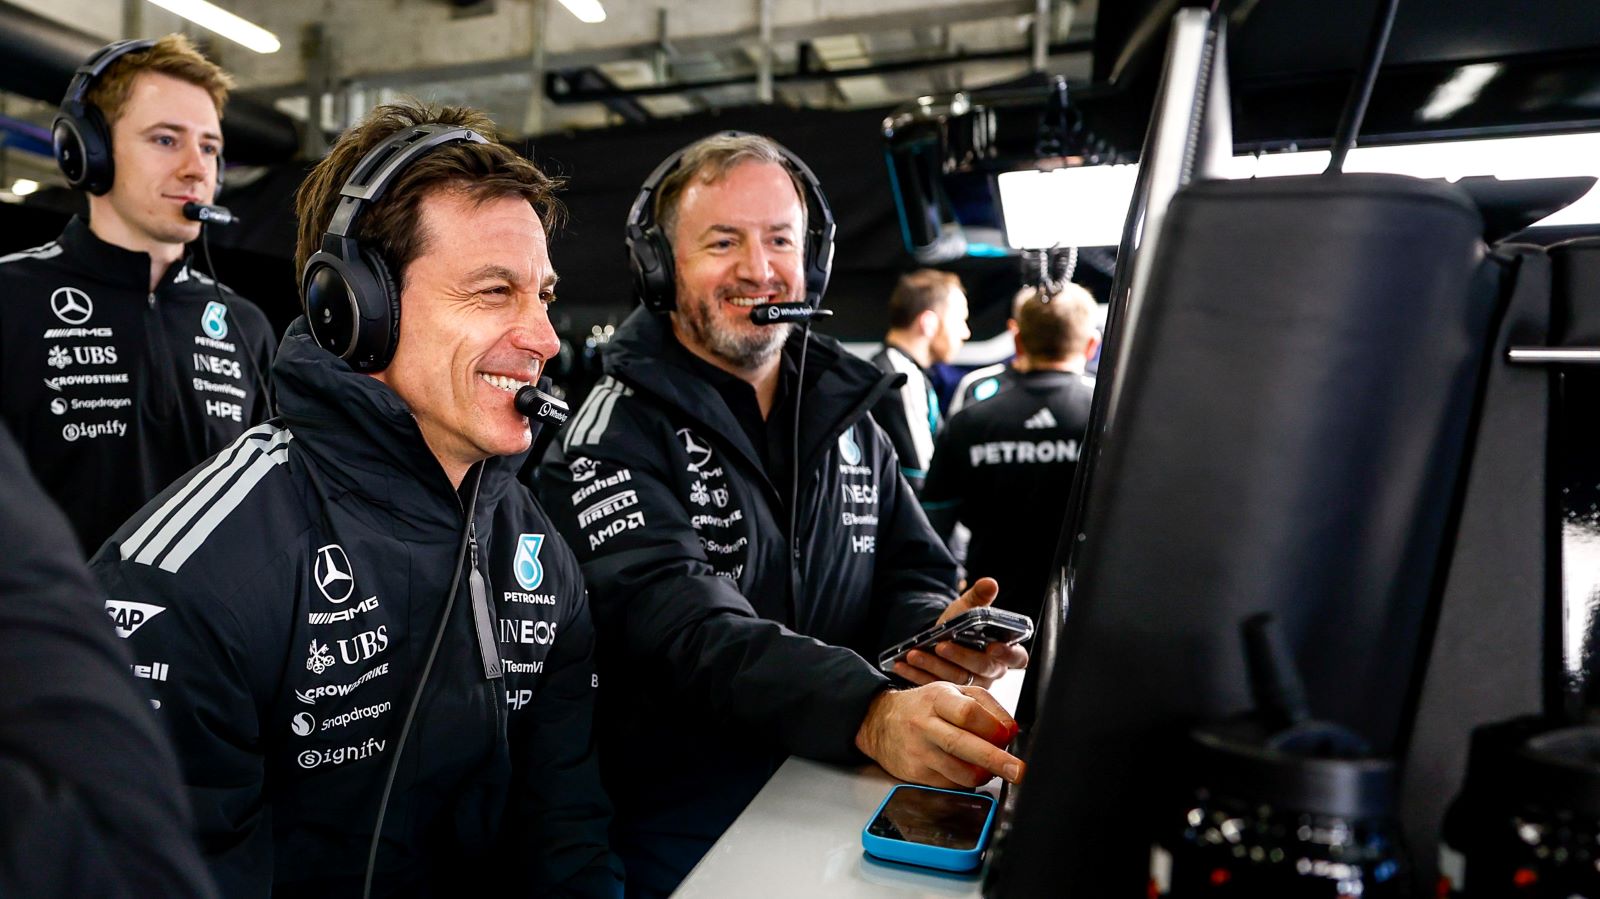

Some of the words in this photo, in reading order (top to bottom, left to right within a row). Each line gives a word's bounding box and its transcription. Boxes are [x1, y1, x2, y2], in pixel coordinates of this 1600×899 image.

[68, 328, 113, 337] AMG
[73, 346, 118, 365] UBS
[193, 353, 242, 379] INEOS
[52, 374, 129, 386] CROWDSTRIKE
[71, 398, 132, 410] Snapdragon
[205, 399, 242, 422] HPE
[970, 439, 1082, 468] PETRON
[571, 469, 631, 506] Einhell
[577, 489, 639, 529] PIRELLI
[588, 518, 627, 551] AMD
[330, 596, 379, 624] AMG
[503, 591, 556, 605] PETRONAS
[500, 619, 557, 644] INEOS
[337, 625, 389, 665] UBS
[505, 660, 544, 674] TeamVi
[305, 663, 389, 699] CROWDSTRIKE
[506, 689, 533, 711] HP
[321, 701, 391, 731] Snapdragon
